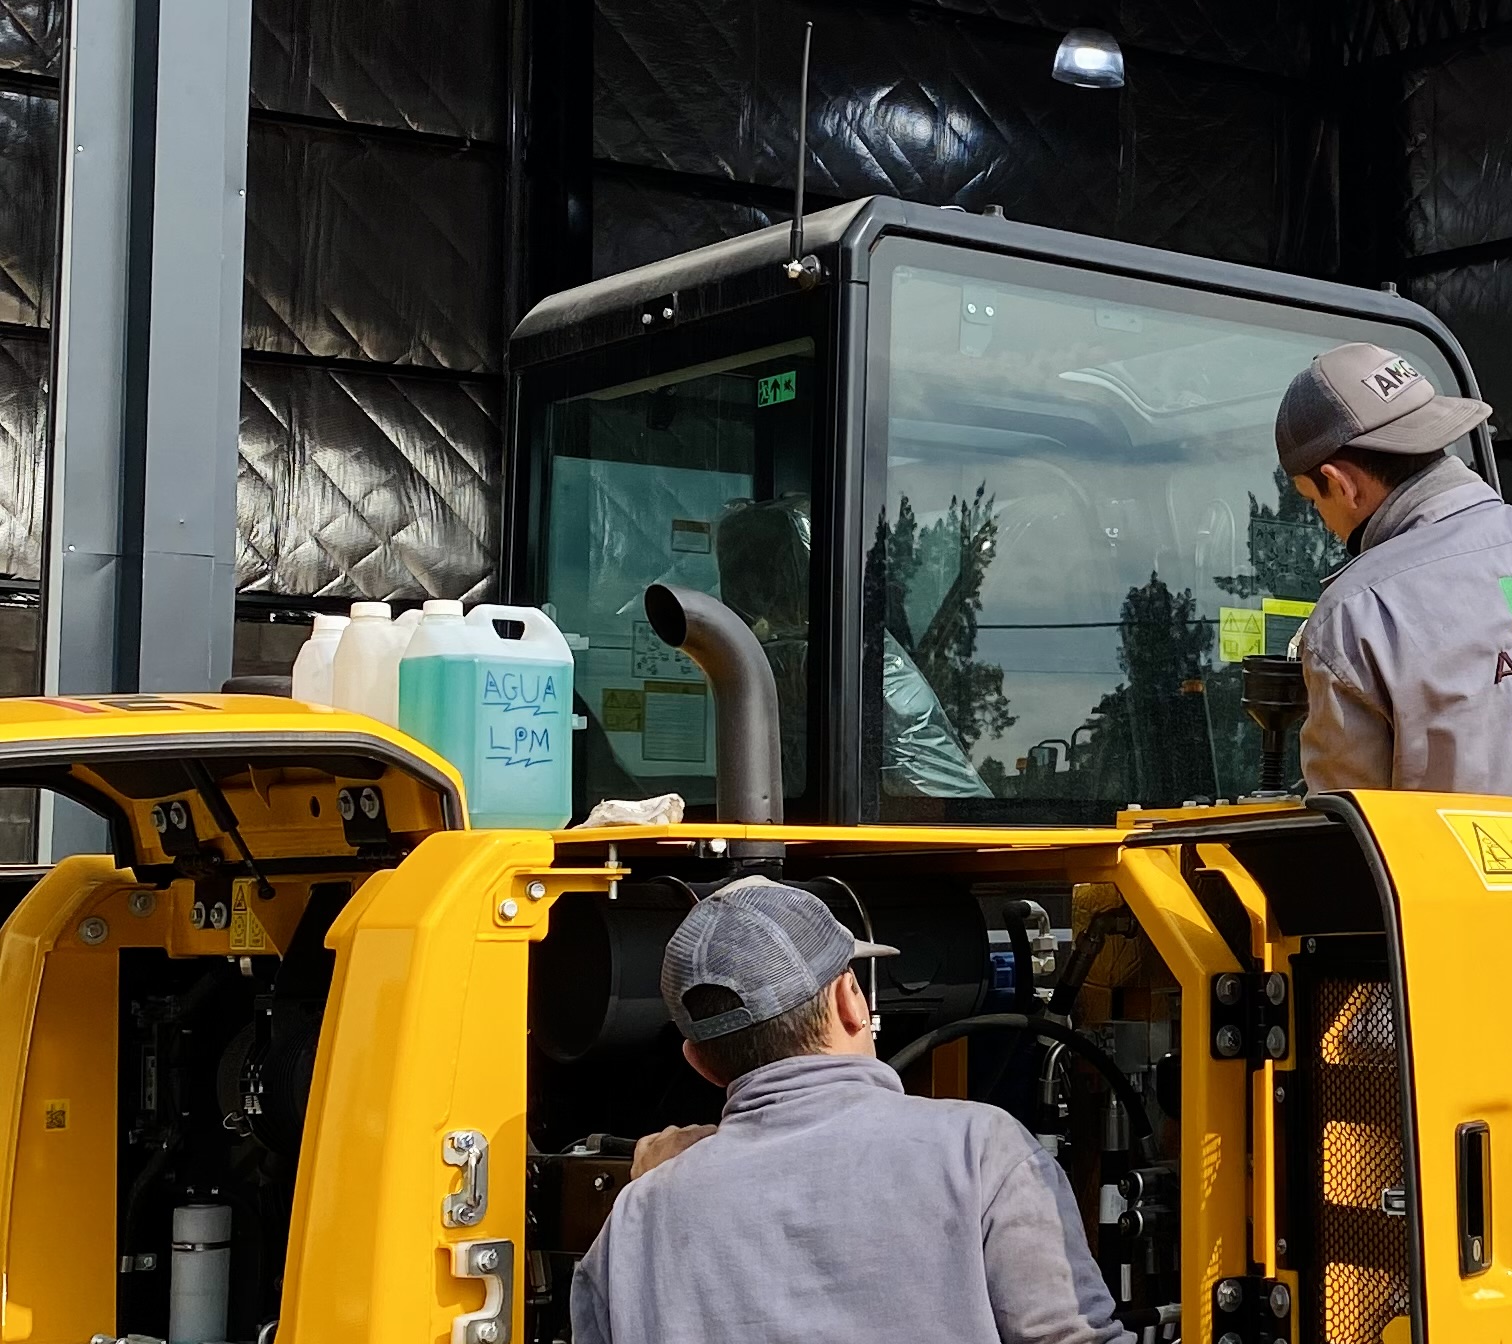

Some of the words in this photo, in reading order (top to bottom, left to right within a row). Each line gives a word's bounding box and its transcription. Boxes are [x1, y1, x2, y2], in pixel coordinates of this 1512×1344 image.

[1374, 359, 1419, 397] AMG
[483, 670, 557, 704] AGUA
[489, 725, 551, 754] LPM
